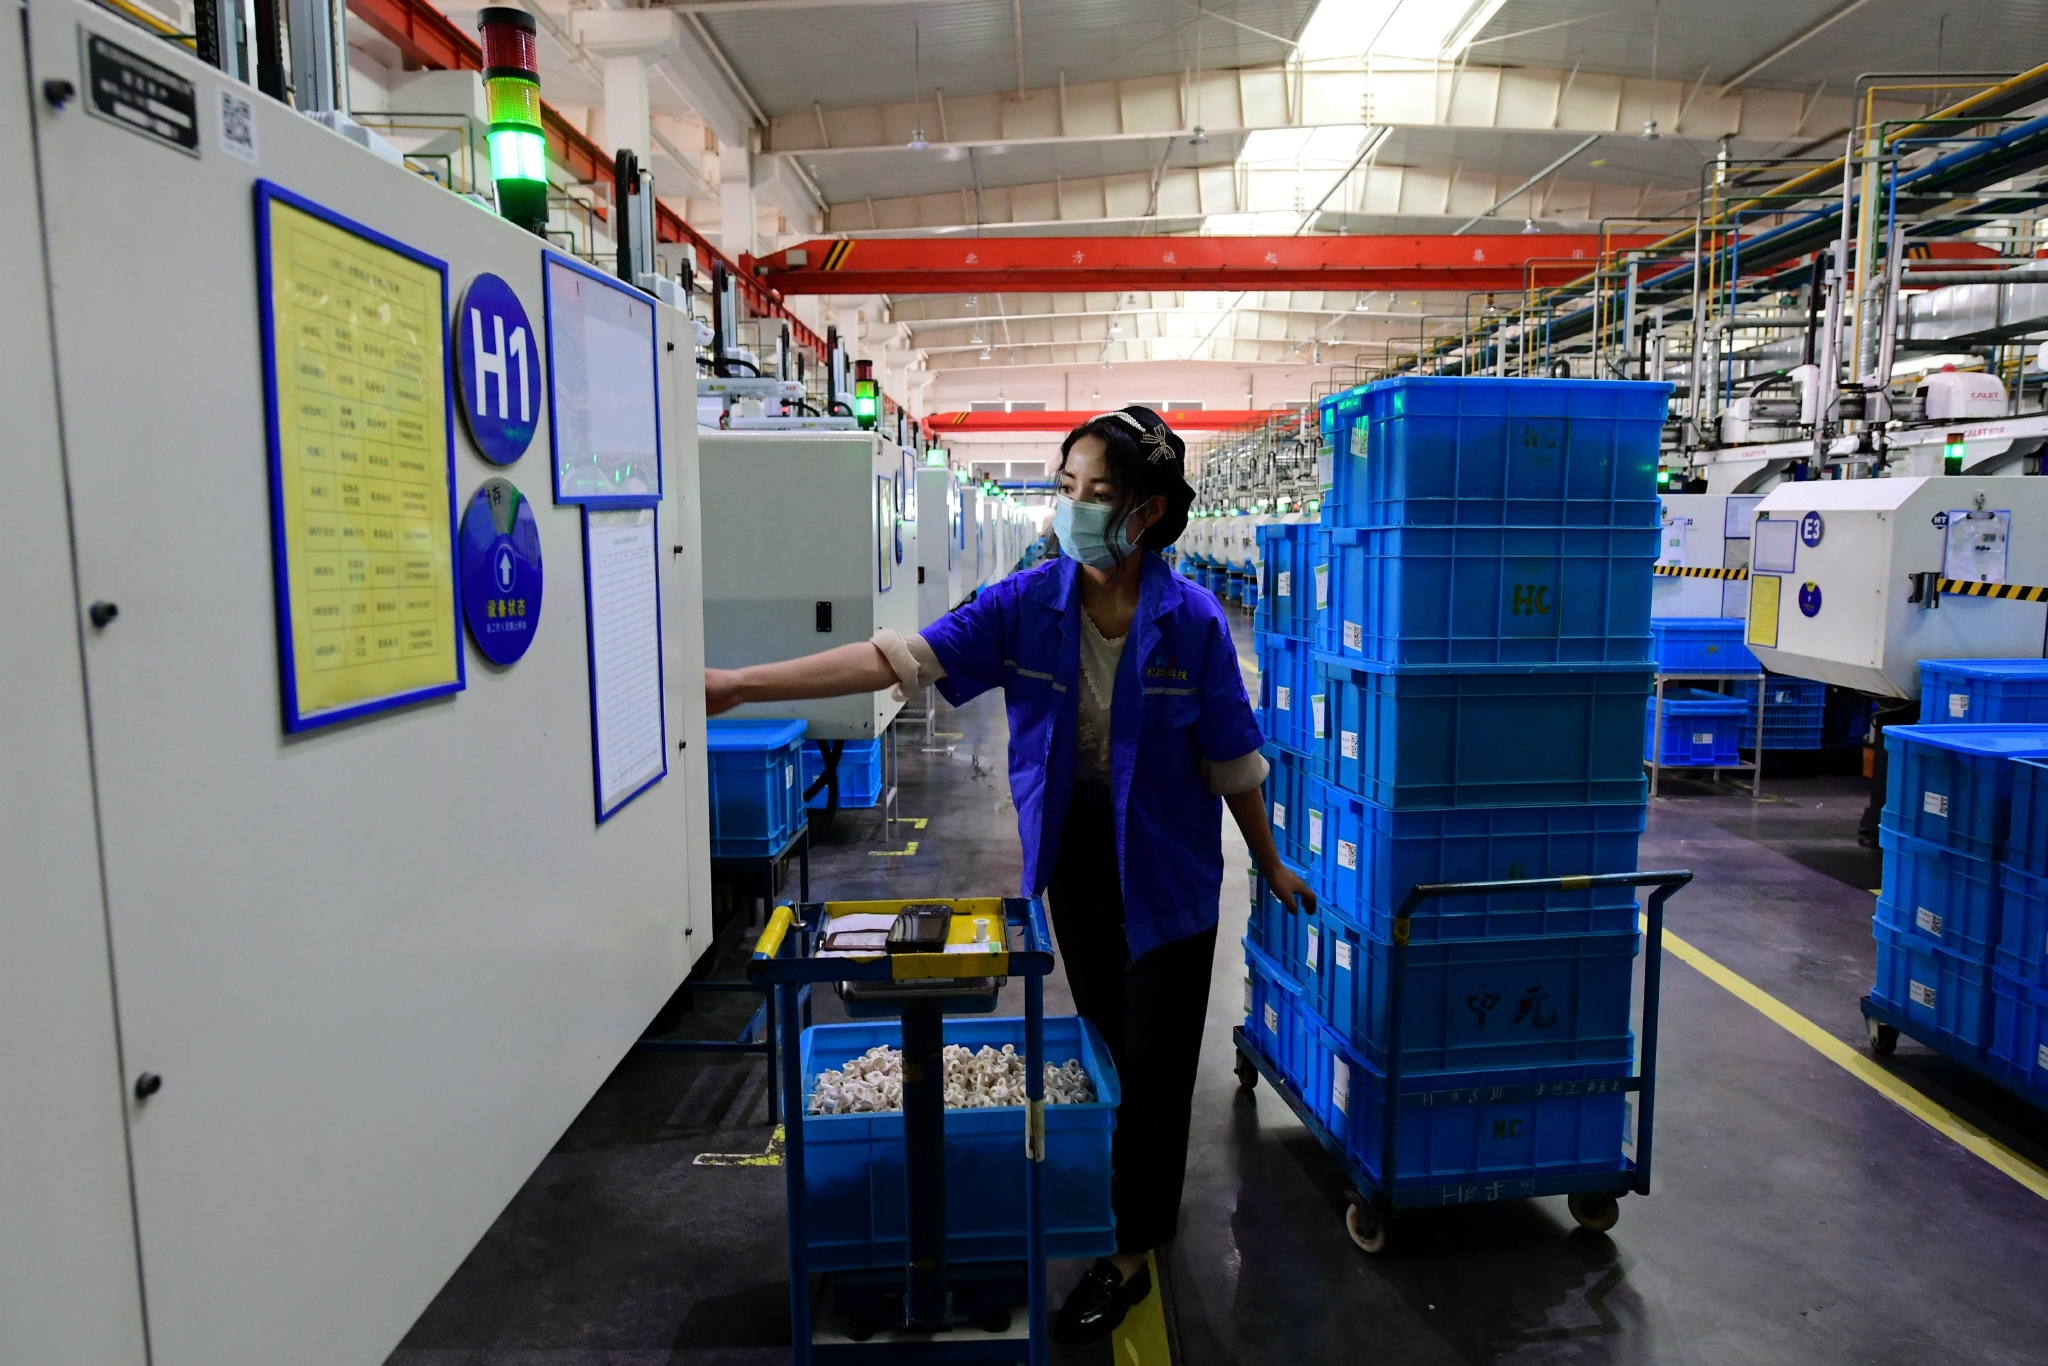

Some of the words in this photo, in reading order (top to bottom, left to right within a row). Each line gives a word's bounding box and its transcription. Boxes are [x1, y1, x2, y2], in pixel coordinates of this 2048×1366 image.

[470, 307, 531, 423] H1
[1804, 518, 1821, 540] E3
[1933, 516, 1948, 524] HT
[487, 597, 526, 619] 设备状态
[1512, 584, 1551, 615] HC
